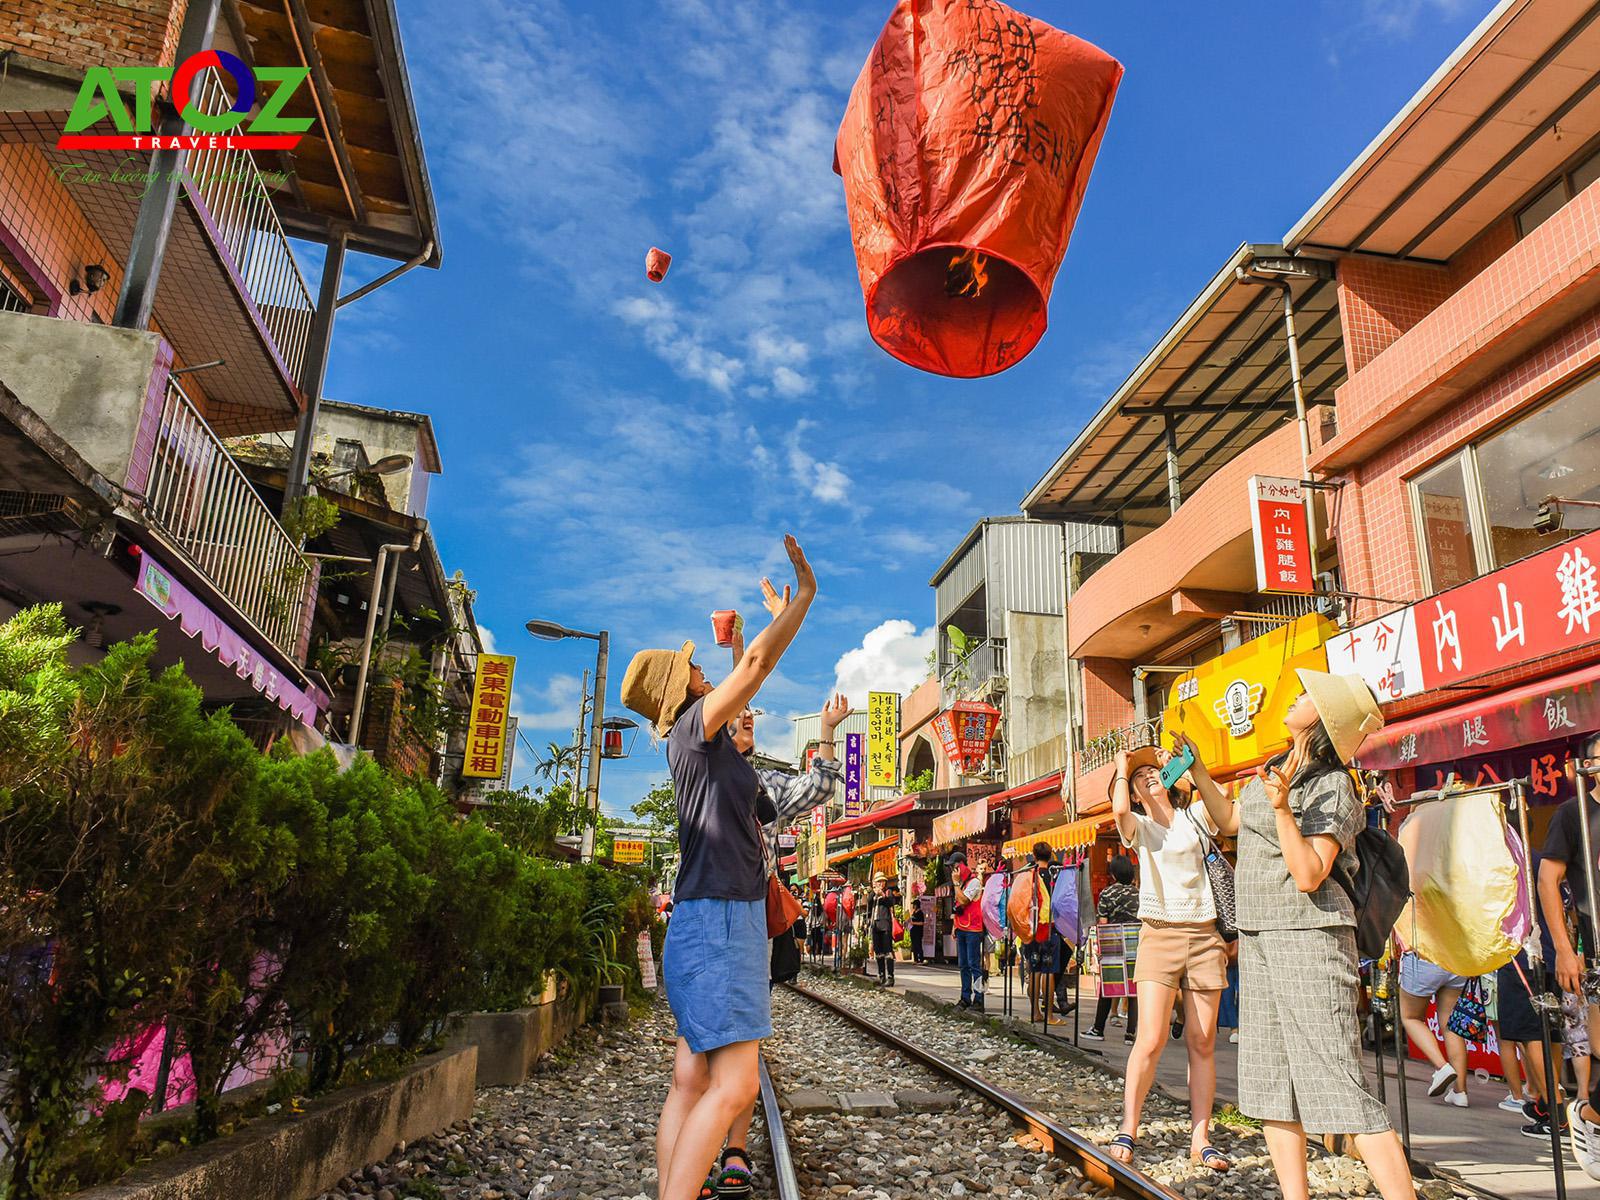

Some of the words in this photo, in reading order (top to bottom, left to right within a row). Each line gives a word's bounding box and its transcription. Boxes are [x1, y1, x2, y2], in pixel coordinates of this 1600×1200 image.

[1257, 481, 1301, 500] 十分好吃
[1343, 621, 1395, 663] 十分
[470, 660, 509, 773] 美果電動車出租
[871, 694, 884, 743] 가용엄마
[1230, 722, 1253, 736] DESIGN
